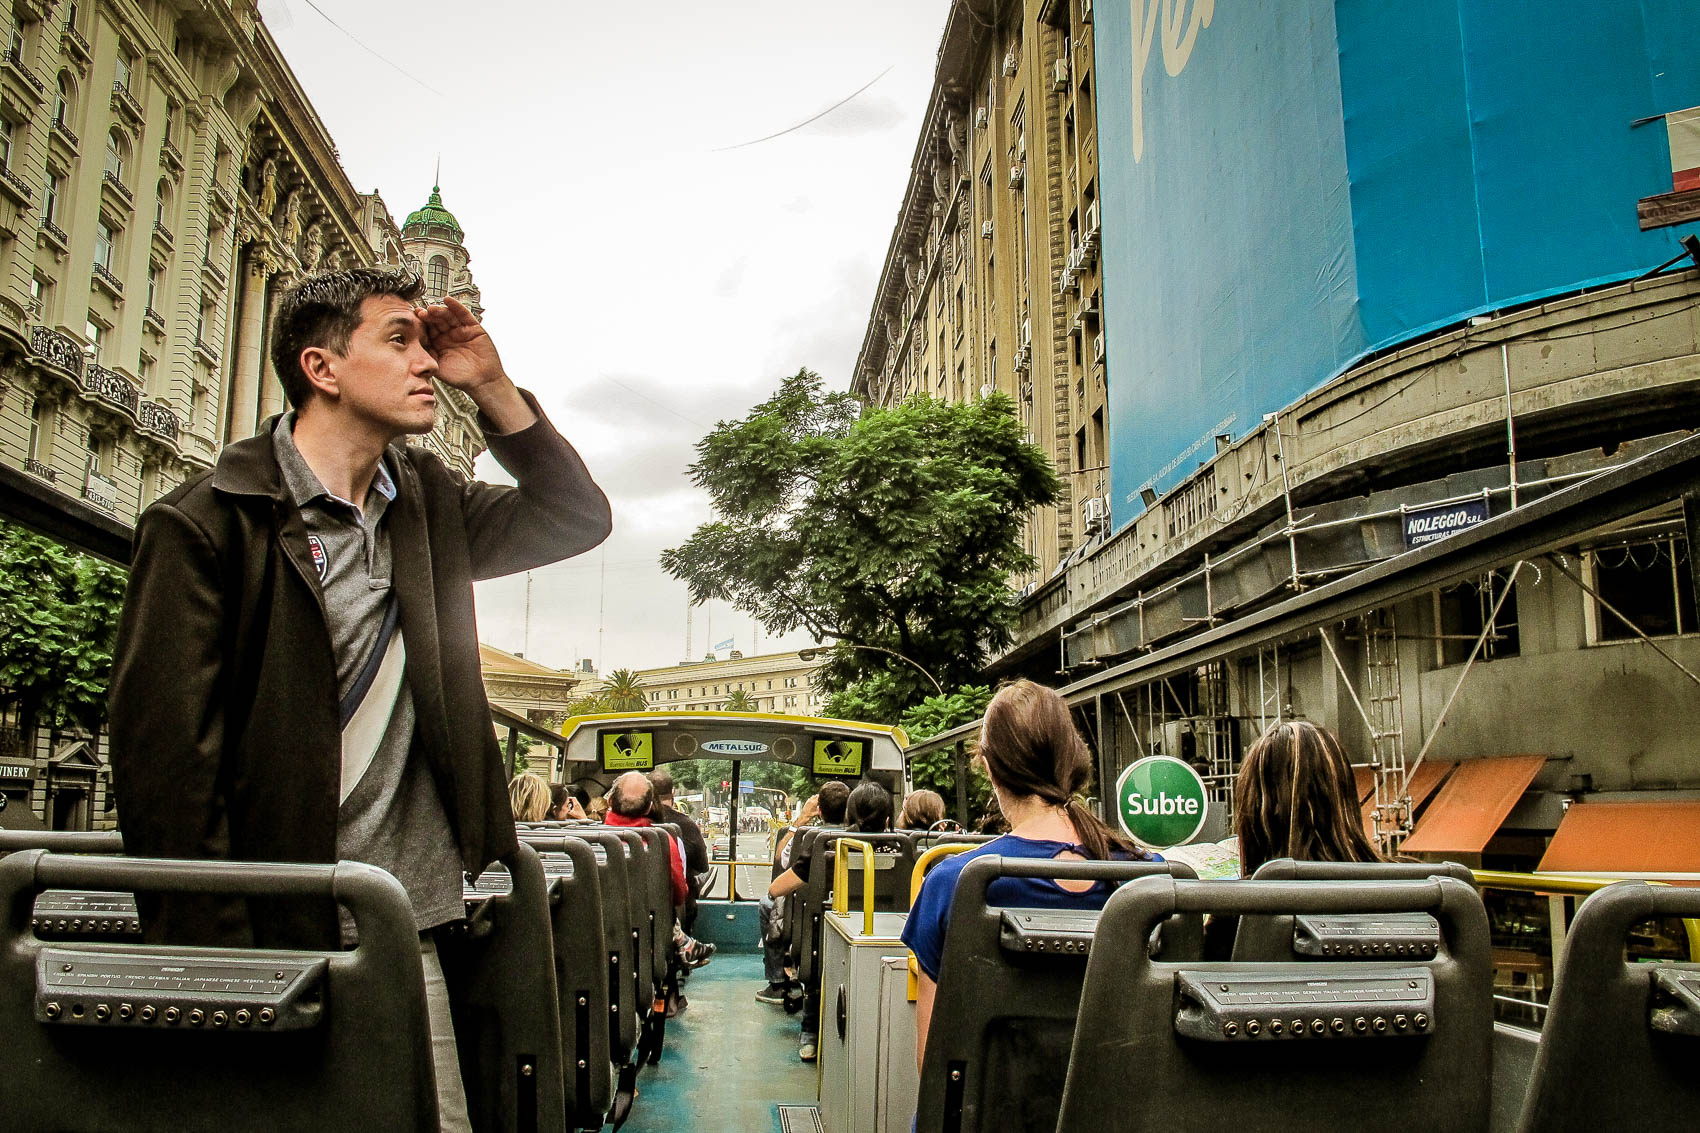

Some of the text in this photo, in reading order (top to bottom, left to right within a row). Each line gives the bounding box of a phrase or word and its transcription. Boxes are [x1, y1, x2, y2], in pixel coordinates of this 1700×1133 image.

[1407, 510, 1467, 535] NOLEGGIO
[708, 743, 762, 752] METALSUR
[635, 760, 648, 768] BUS
[1127, 791, 1199, 815] Subte
